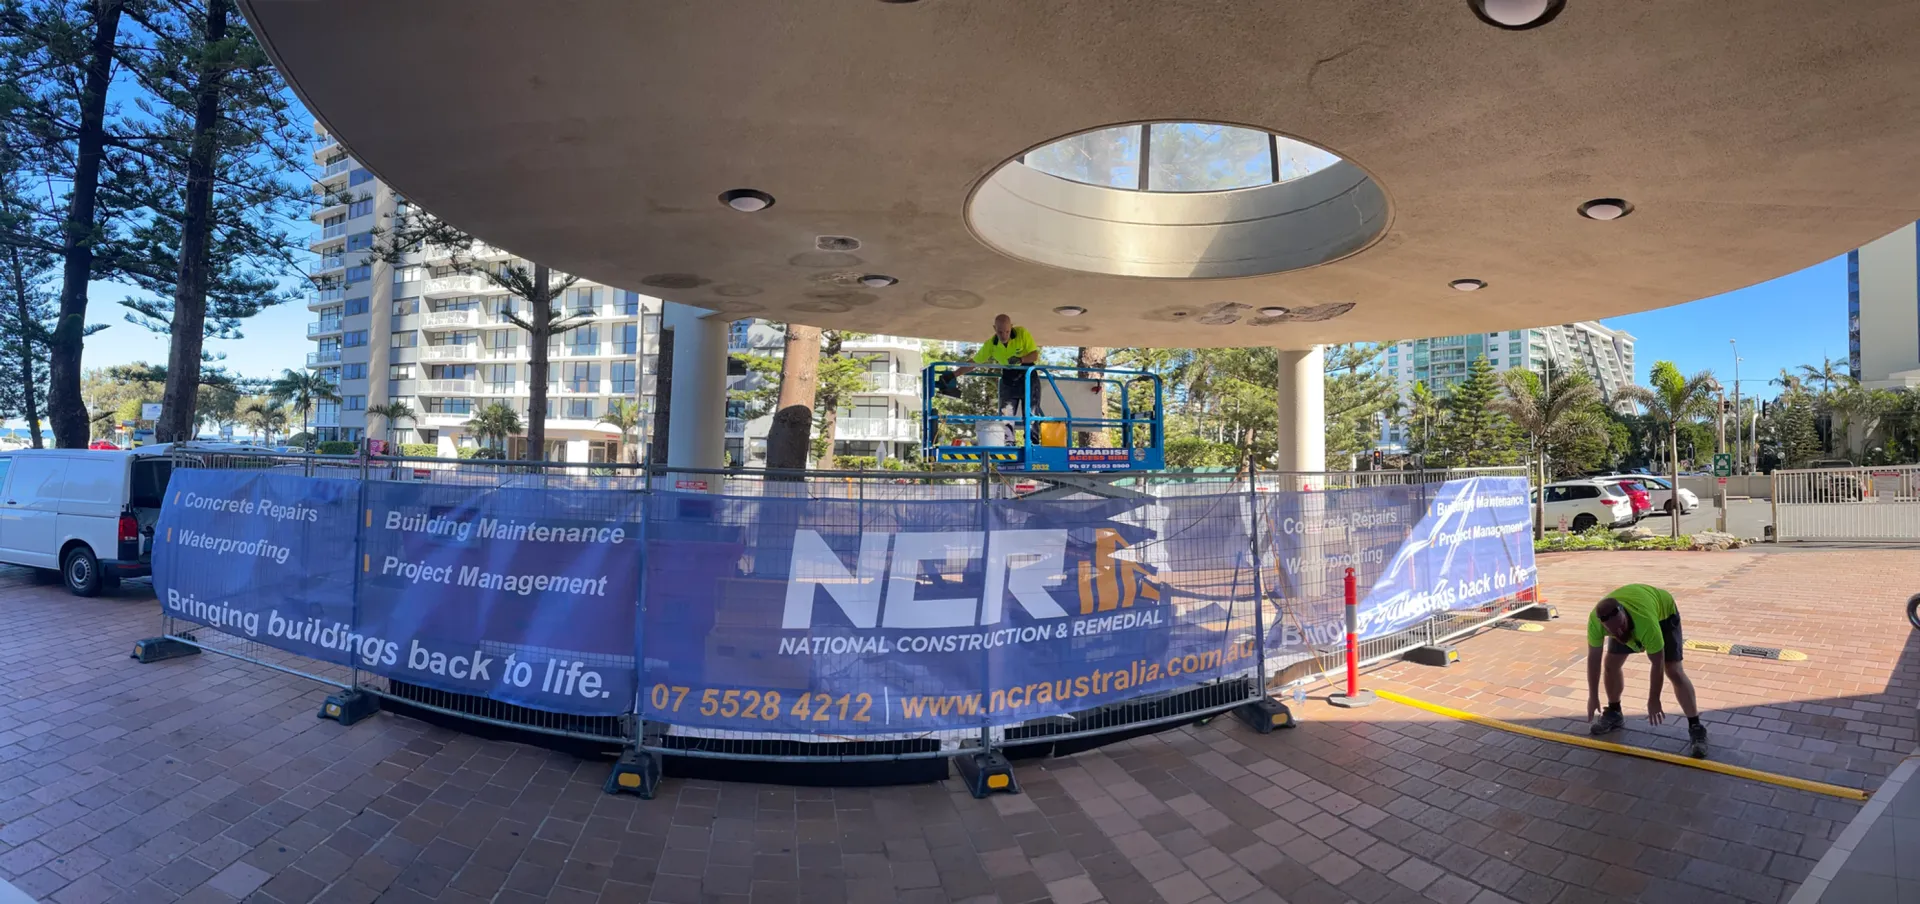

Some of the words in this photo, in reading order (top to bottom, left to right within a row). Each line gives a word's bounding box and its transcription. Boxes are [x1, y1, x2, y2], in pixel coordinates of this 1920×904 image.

[185, 492, 254, 515] Concrete
[257, 499, 319, 522] Repairs
[1476, 495, 1525, 509] Maintenance
[384, 510, 472, 542] Building
[476, 518, 626, 545] Maintenance
[1283, 513, 1348, 535] Corete
[1351, 510, 1398, 530] Repairs
[1473, 521, 1523, 538] Management
[178, 528, 291, 565] Waterproofing
[383, 556, 453, 584] Project
[457, 566, 608, 597] Management
[781, 528, 1069, 629] NCR
[1281, 612, 1371, 646] Bringig
[1459, 573, 1491, 599] back
[1494, 570, 1506, 590] to
[167, 587, 260, 638] Bringing
[267, 609, 399, 666] buildings
[408, 639, 494, 681] back
[502, 652, 533, 689] to
[541, 657, 610, 699] life.
[778, 636, 890, 656] NATIONAL
[896, 624, 1051, 654] CONSTRUCTION
[1055, 623, 1068, 639] &
[1073, 609, 1163, 637] REMEDIAL
[900, 640, 1255, 719] www.ncraustralia.com.au
[651, 683, 691, 713] 07
[699, 688, 782, 721] 5528
[790, 691, 873, 723] 4212
